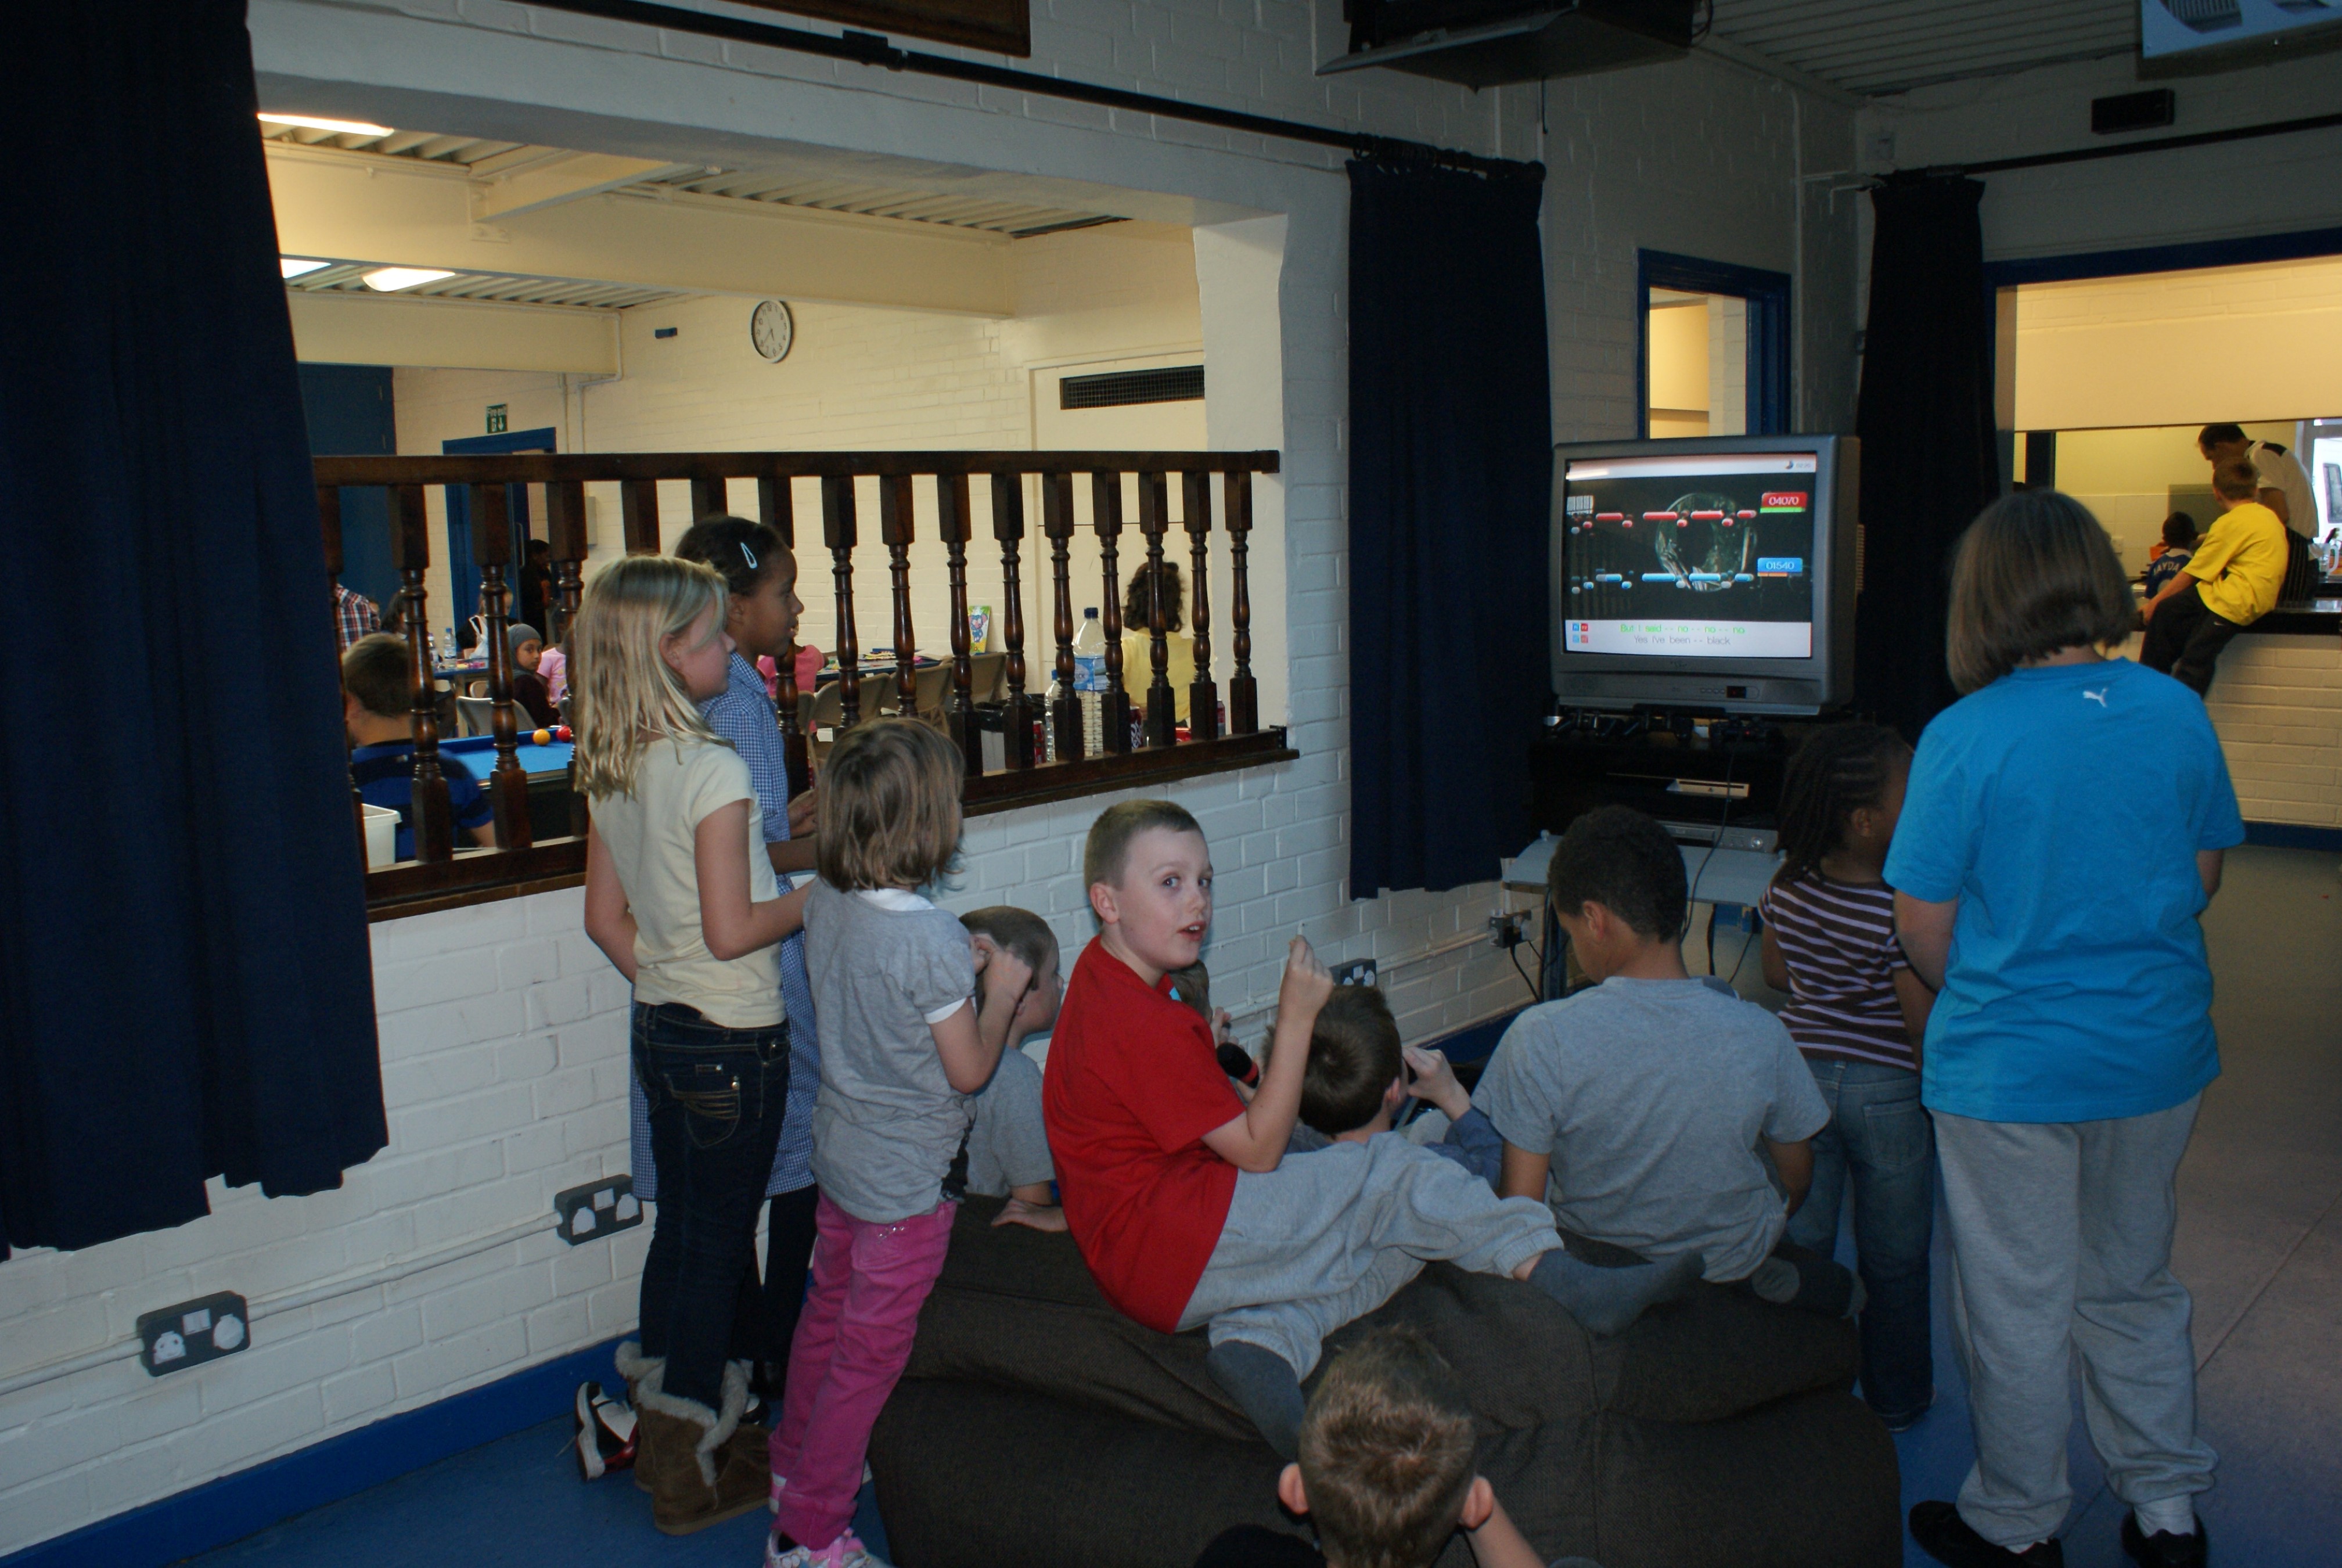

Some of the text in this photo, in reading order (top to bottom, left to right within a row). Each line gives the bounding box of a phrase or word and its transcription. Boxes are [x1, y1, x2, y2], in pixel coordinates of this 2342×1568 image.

[1768, 496, 1800, 506] 04070
[1766, 561, 1795, 570] 01540
[1620, 624, 1634, 632] But
[1645, 624, 1661, 632] said
[1634, 635, 1648, 643] Yes
[1670, 635, 1690, 644] been
[1707, 636, 1731, 645] black
